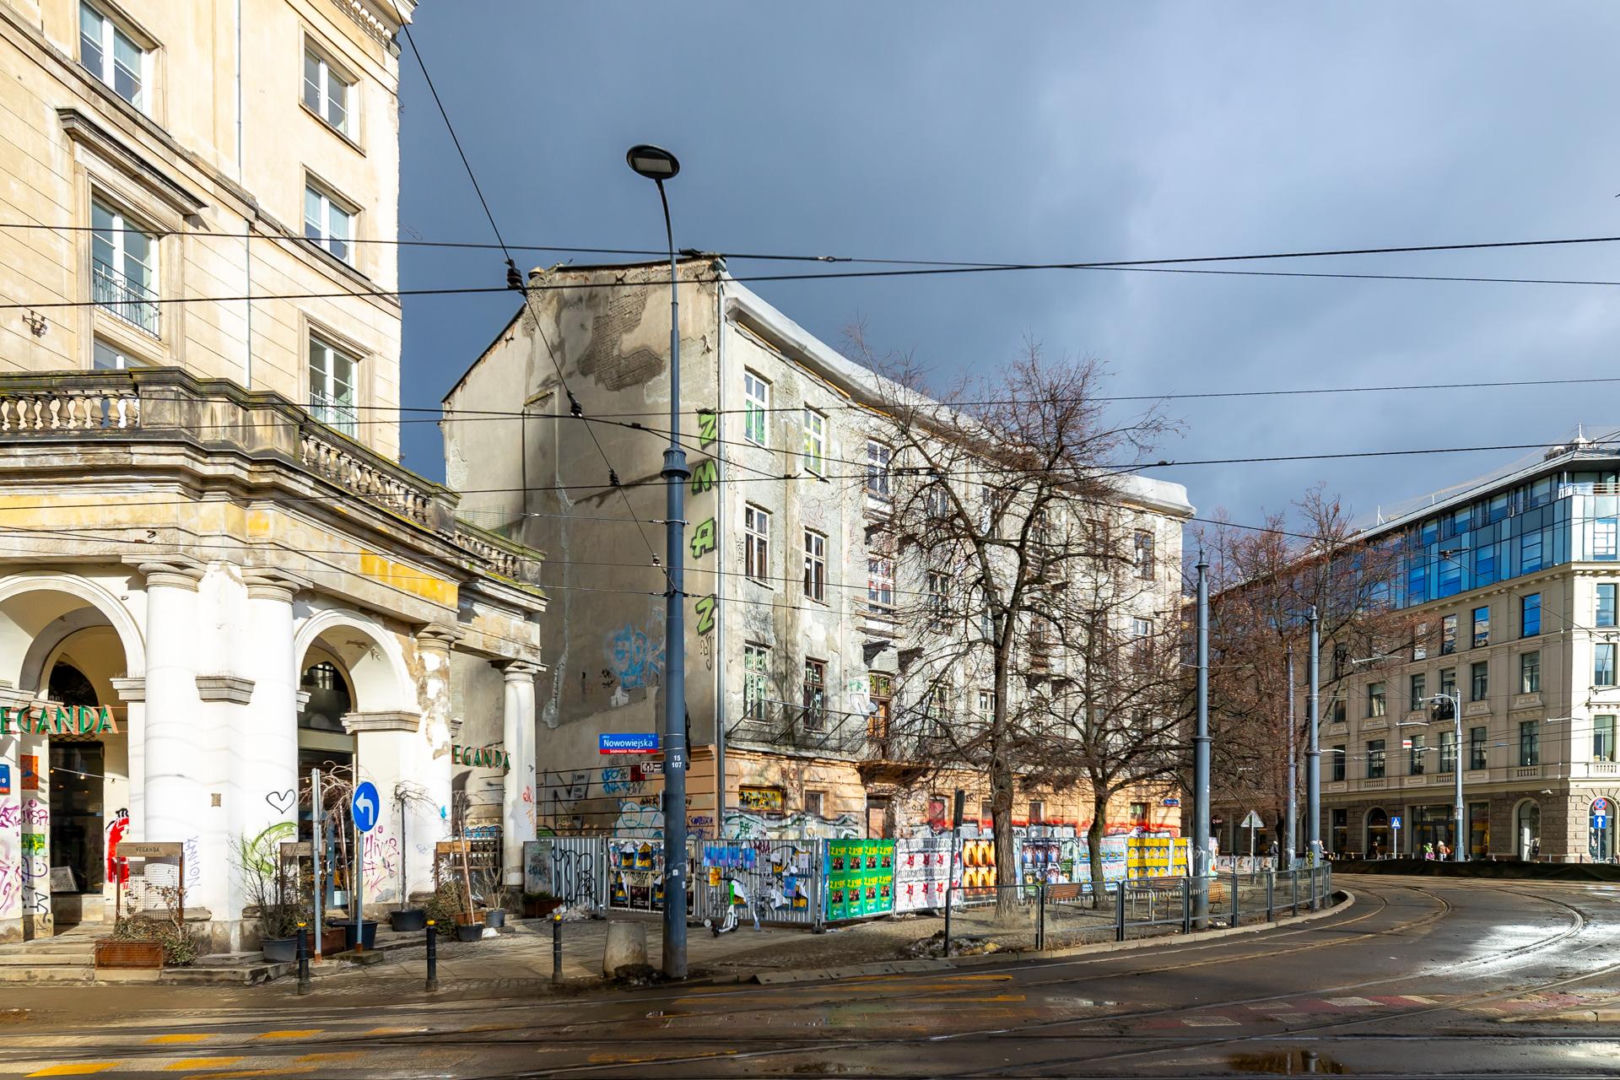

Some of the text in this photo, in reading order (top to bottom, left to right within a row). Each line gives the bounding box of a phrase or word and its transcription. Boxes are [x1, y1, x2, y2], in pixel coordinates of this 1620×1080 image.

[0, 704, 119, 735] EGANDA
[603, 738, 653, 749] Nowowiejska
[452, 744, 510, 771] EGANDA
